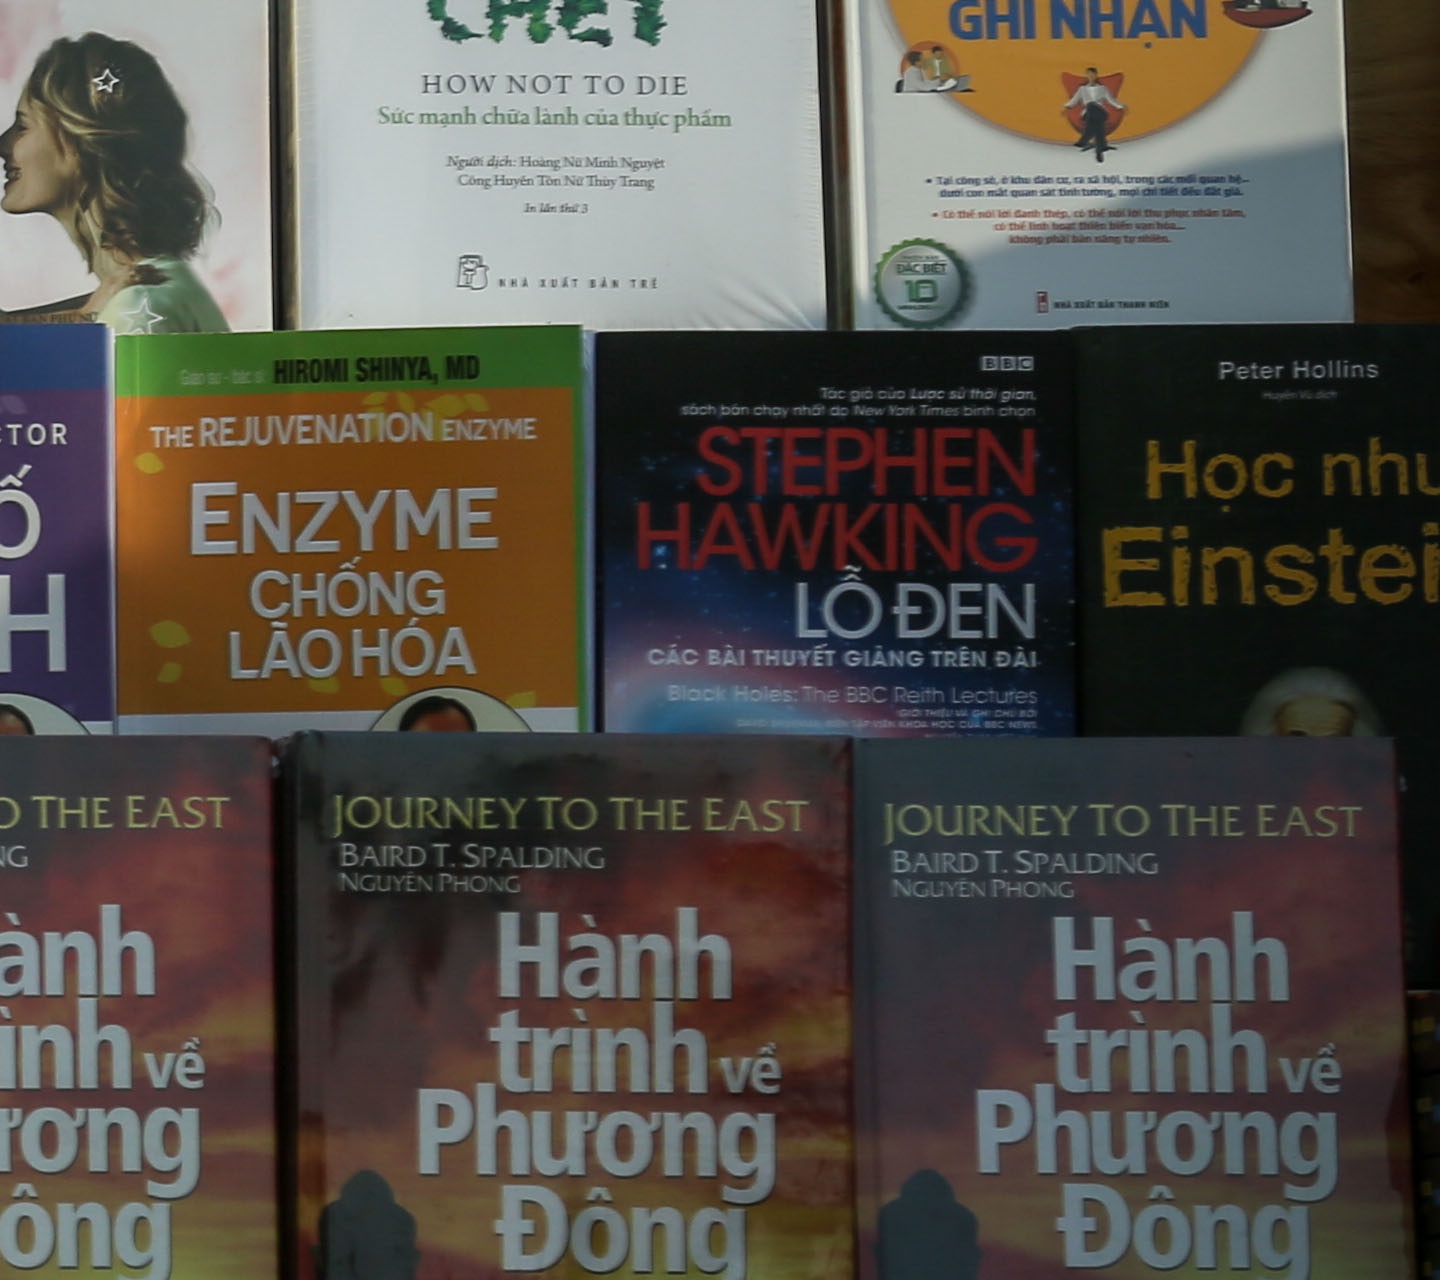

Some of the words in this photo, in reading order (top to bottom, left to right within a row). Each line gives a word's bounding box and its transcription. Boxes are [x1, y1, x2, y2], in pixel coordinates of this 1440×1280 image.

[1218, 361, 1283, 380] Peter
[1292, 361, 1380, 379] Hollins
[695, 425, 1036, 497] STEPHEN
[1146, 439, 1295, 512] Học
[636, 502, 1039, 572] HAWKING
[250, 556, 446, 619] CHỐNG
[795, 565, 882, 640] LỖ
[892, 582, 1036, 640] ĐEN
[230, 621, 342, 679] LÃO
[352, 617, 477, 676] HÓA
[32, 796, 111, 829] THE
[498, 906, 733, 1001] Hành
[1053, 911, 1289, 1002] Hành
[489, 1002, 708, 1094] trình
[1046, 1003, 1268, 1094] trình
[417, 1083, 777, 1205] Phương
[976, 1083, 1338, 1203] Phương
